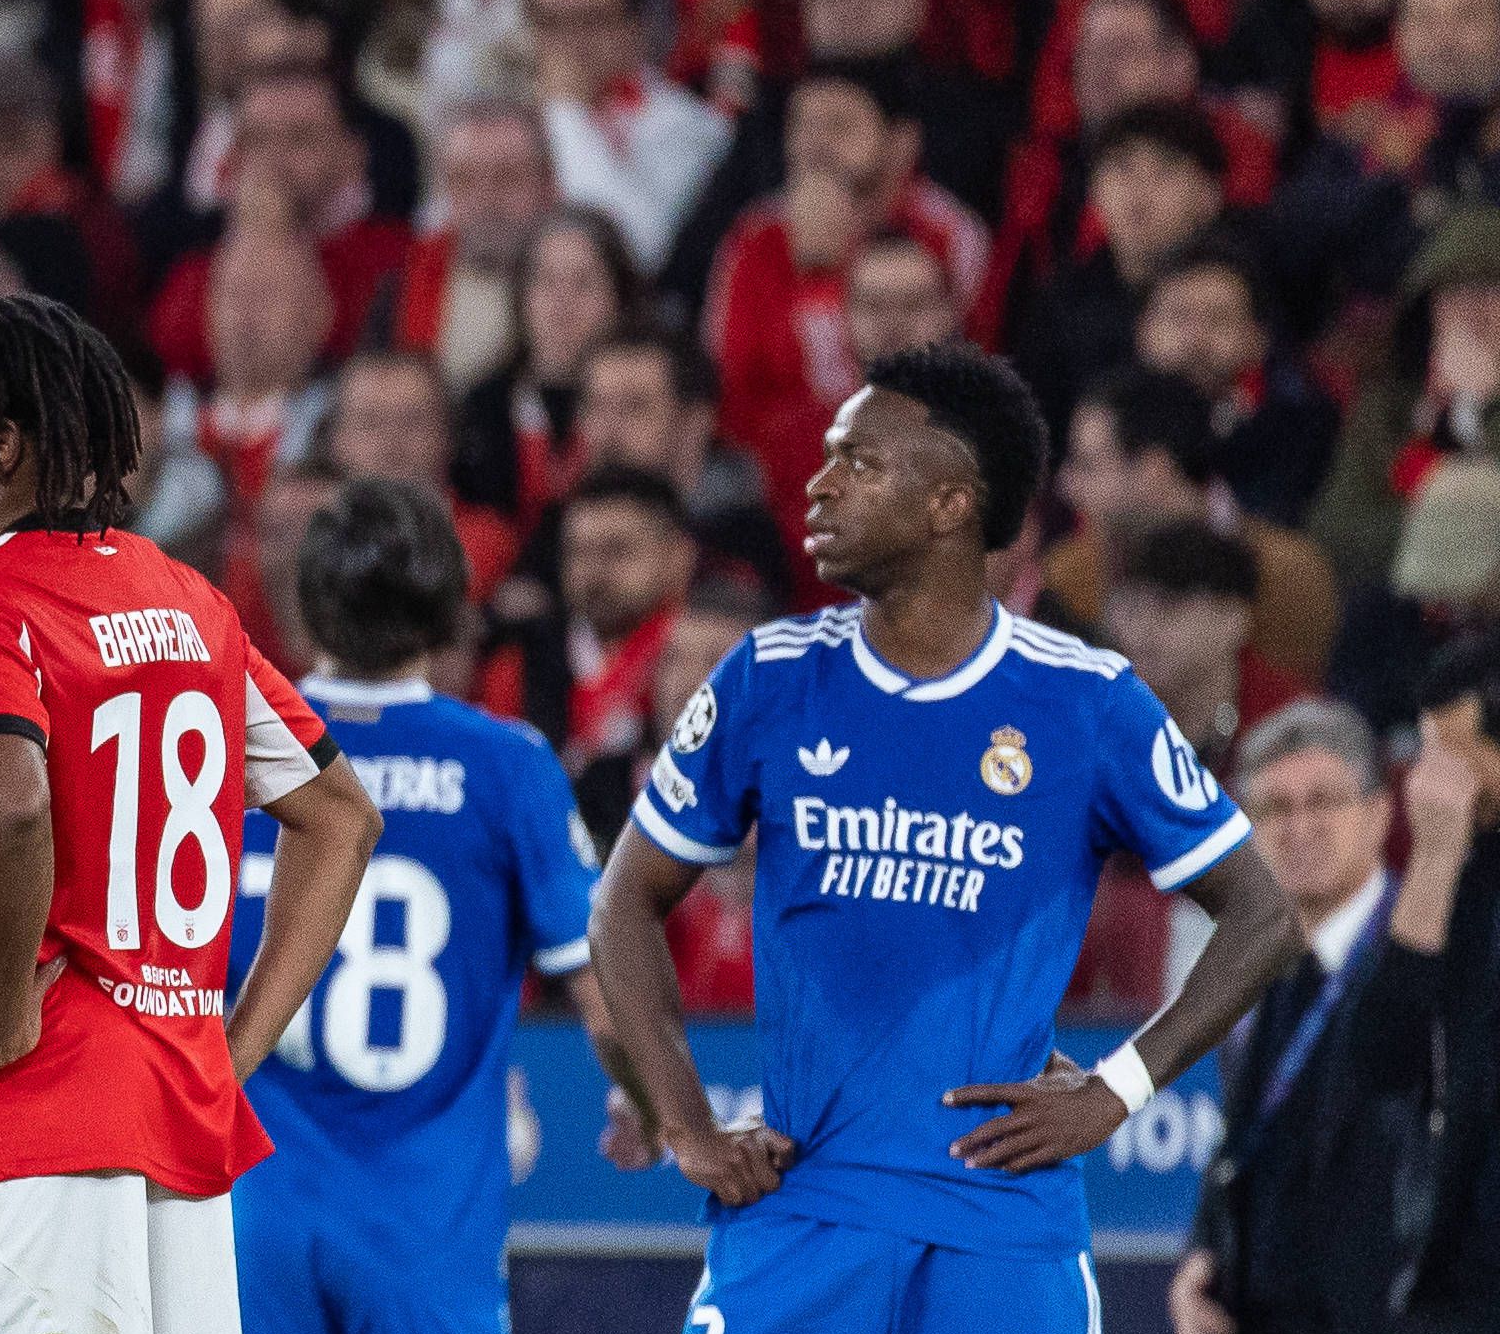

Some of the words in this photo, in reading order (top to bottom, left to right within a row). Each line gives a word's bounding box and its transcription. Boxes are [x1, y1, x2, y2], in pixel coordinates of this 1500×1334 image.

[90, 690, 232, 950] 18
[793, 796, 1024, 870] Emirates
[871, 855, 985, 913] BETTER
